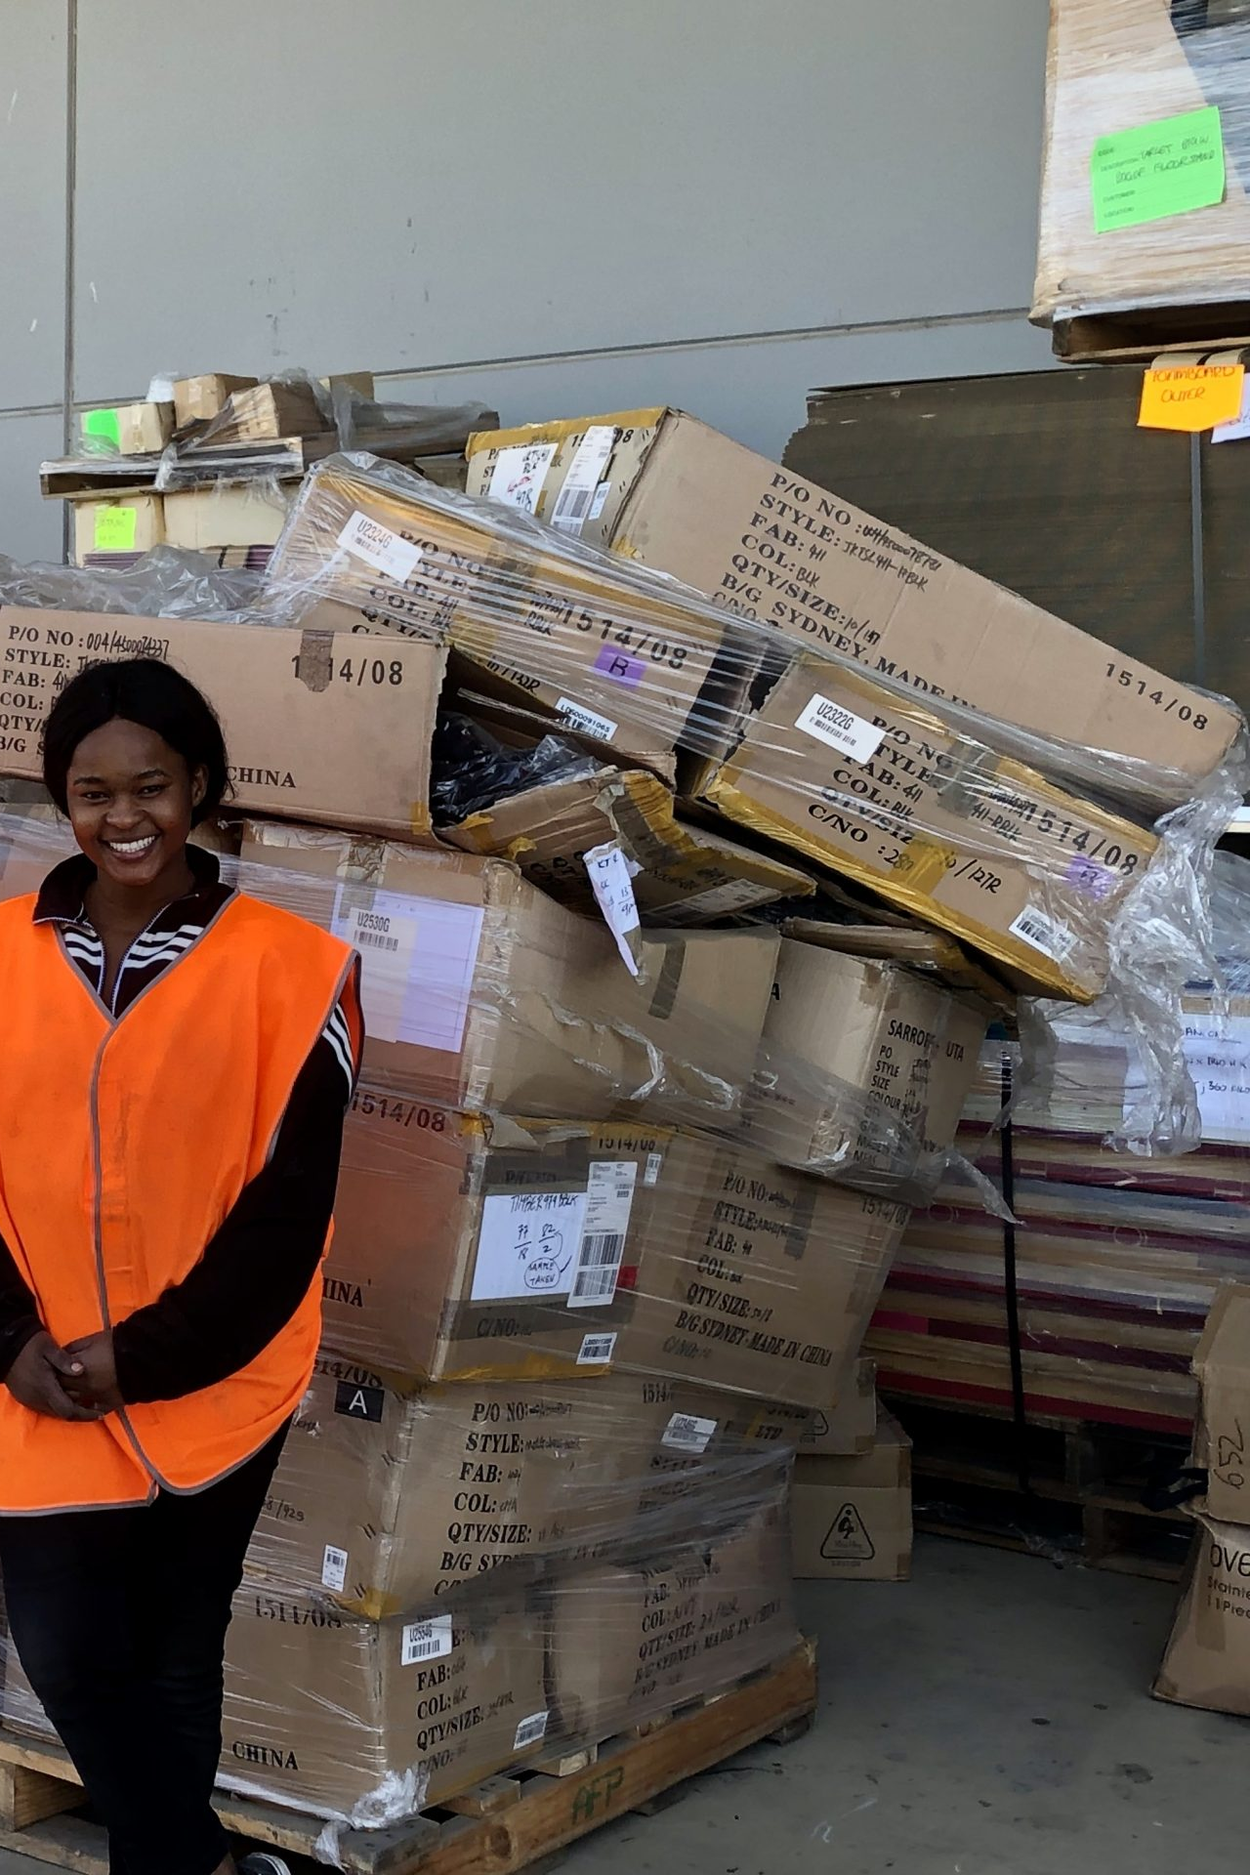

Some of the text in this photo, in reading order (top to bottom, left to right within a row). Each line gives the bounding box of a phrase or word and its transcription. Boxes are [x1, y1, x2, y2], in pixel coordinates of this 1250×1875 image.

[1160, 386, 1206, 403] OUTER
[770, 472, 852, 526] P/O NO
[749, 511, 805, 552] FAB:
[759, 492, 841, 547] STYLE:
[741, 533, 796, 572] COL:
[720, 572, 762, 604] B/G
[731, 553, 847, 625] QTY/SIZE:
[8, 625, 39, 643] P/O
[47, 629, 74, 646] NO
[563, 605, 689, 671] 1514/08
[4, 648, 71, 668] STYLE:
[1, 669, 46, 688] FAB:
[0, 692, 44, 711] COL:
[1105, 661, 1210, 731] 1514/08
[815, 701, 856, 731] U2322G
[871, 714, 911, 746] P/O
[227, 765, 297, 789] CHINA
[832, 768, 890, 804] COL:
[356, 911, 390, 933] U2530G
[879, 1044, 893, 1059] PO
[871, 1074, 891, 1091] SIZE
[875, 1061, 900, 1078] STYLE
[351, 1090, 447, 1134] 1514/08
[723, 1170, 745, 1193] P/O
[705, 1230, 738, 1255] FAB:
[529, 1273, 556, 1286] TAKEN
[697, 1254, 730, 1281] COL:
[687, 1282, 750, 1319] QTY/SIZE:
[675, 1310, 700, 1333] B/G
[751, 1332, 786, 1357] MADE
[784, 1339, 799, 1359] IN
[800, 1341, 833, 1367] CHINA
[348, 1389, 368, 1415] A
[471, 1402, 500, 1424] P/O
[465, 1432, 525, 1454] STYLE:
[1213, 1417, 1245, 1490] 652
[459, 1461, 503, 1483] FAB:
[454, 1492, 497, 1514] COL:
[447, 1521, 532, 1545] QTY/SIZE:
[440, 1552, 472, 1573] B/G
[416, 1664, 451, 1692] FAB:
[416, 1693, 452, 1720] COL:
[416, 1705, 484, 1751] QTY/SIZE:
[232, 1741, 299, 1771] CHINA
